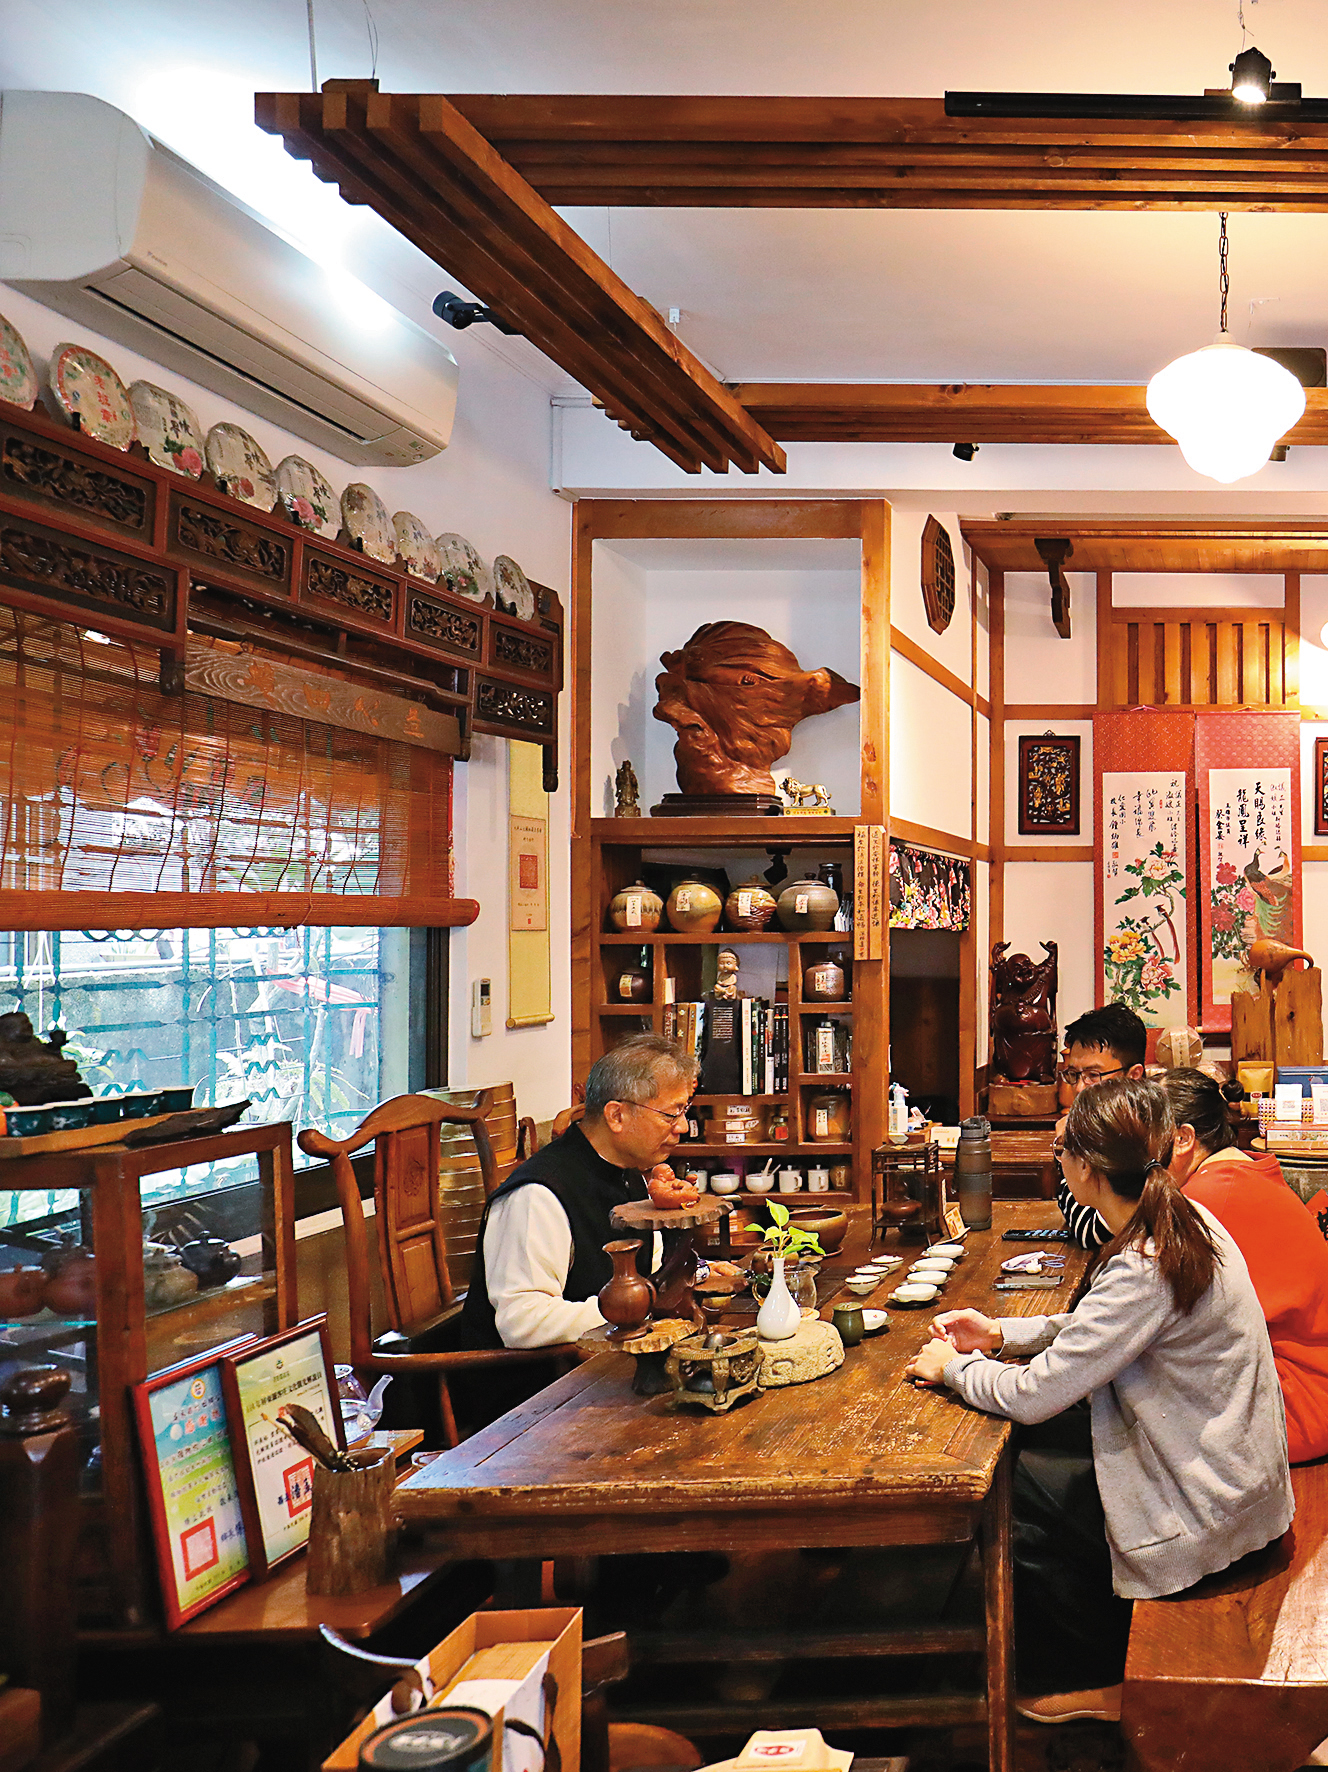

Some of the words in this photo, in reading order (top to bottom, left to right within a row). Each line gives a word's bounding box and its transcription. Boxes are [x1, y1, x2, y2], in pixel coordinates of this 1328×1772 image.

[1236, 788, 1250, 849] 龍鳳呈祥
[1254, 781, 1267, 842] 天賜良緣
